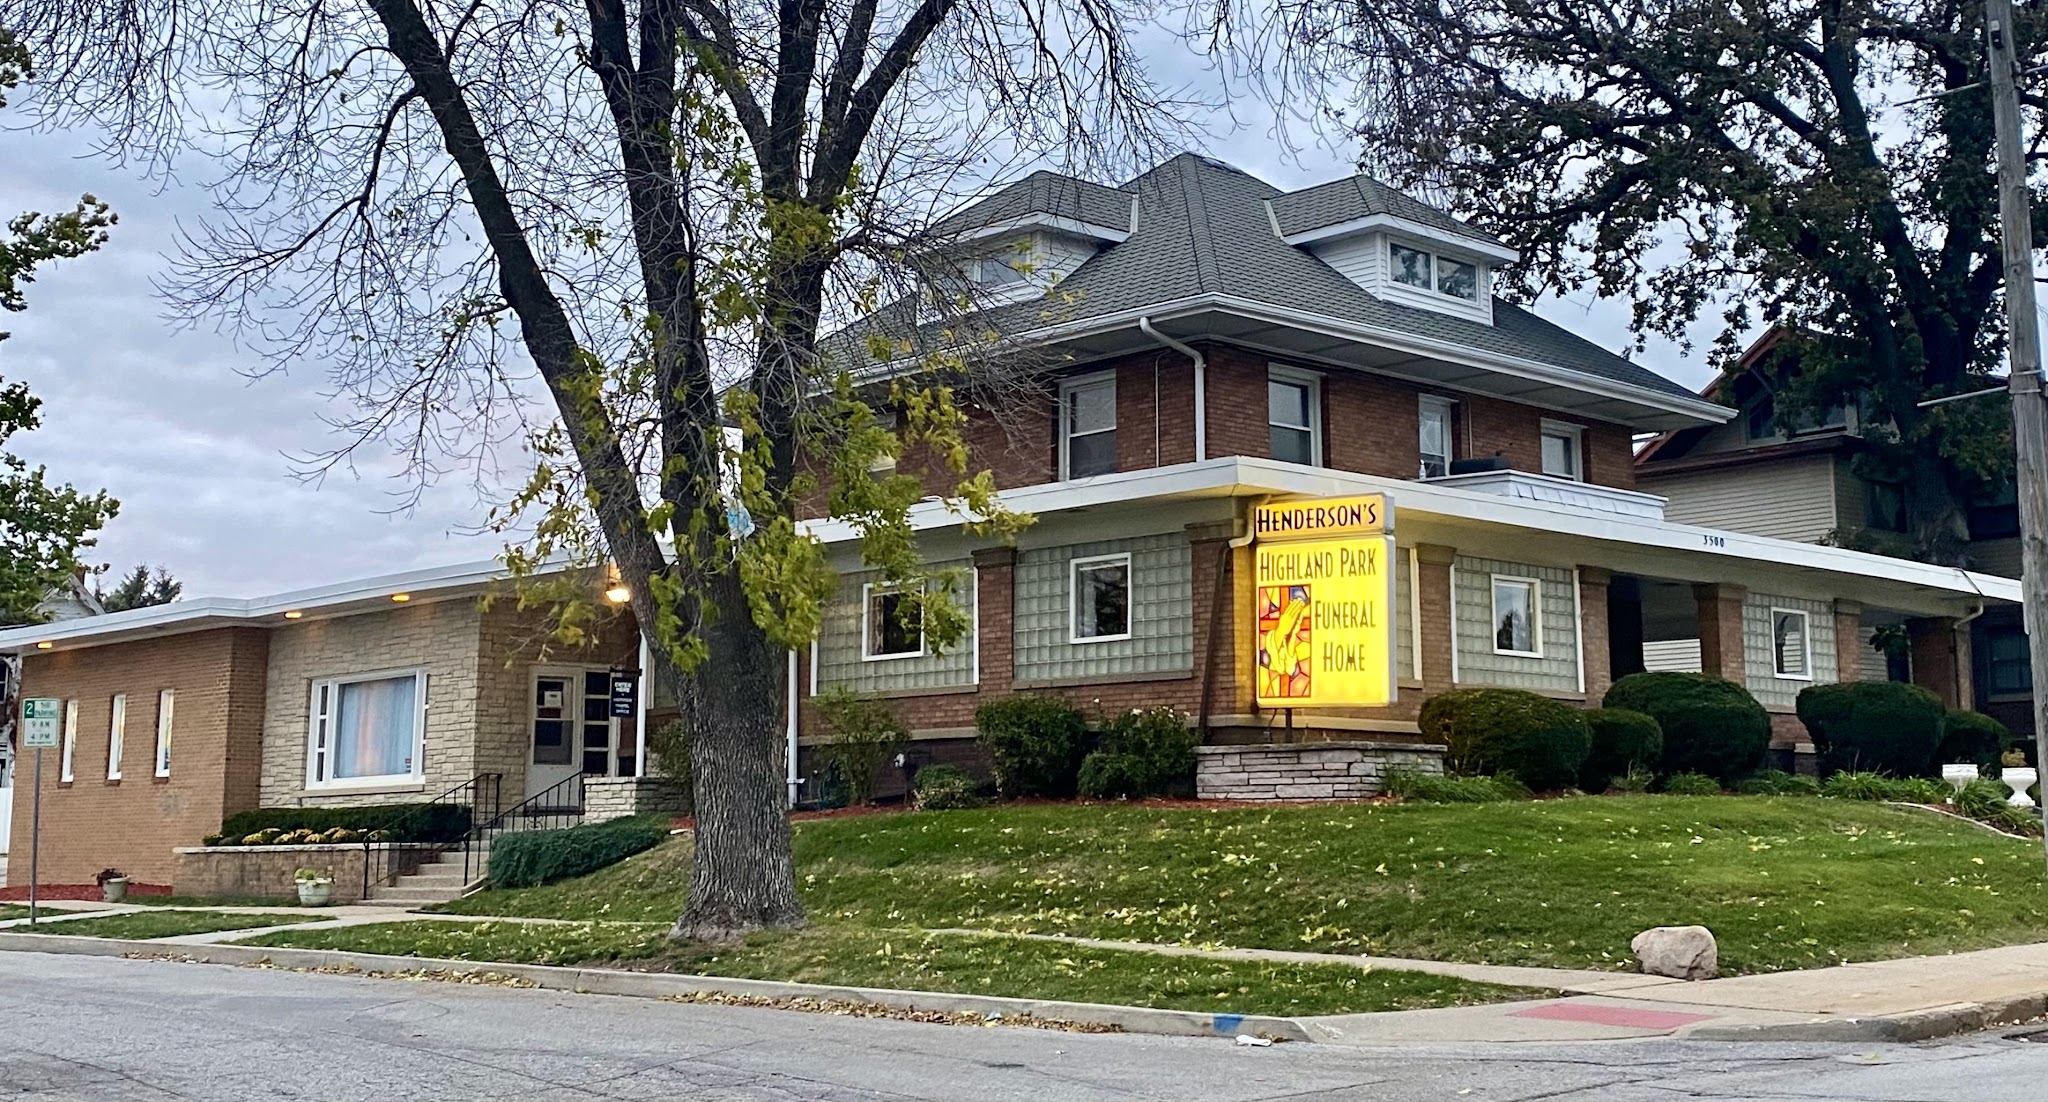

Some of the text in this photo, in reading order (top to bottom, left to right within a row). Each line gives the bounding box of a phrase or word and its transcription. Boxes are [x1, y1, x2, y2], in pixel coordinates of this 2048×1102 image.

[1257, 503, 1377, 533] HENDERSON'S
[1259, 547, 1377, 582] HIGHLAND PARK
[1314, 600, 1376, 630] FUNERAL
[1323, 641, 1366, 673] HOME
[25, 702, 34, 715] 2
